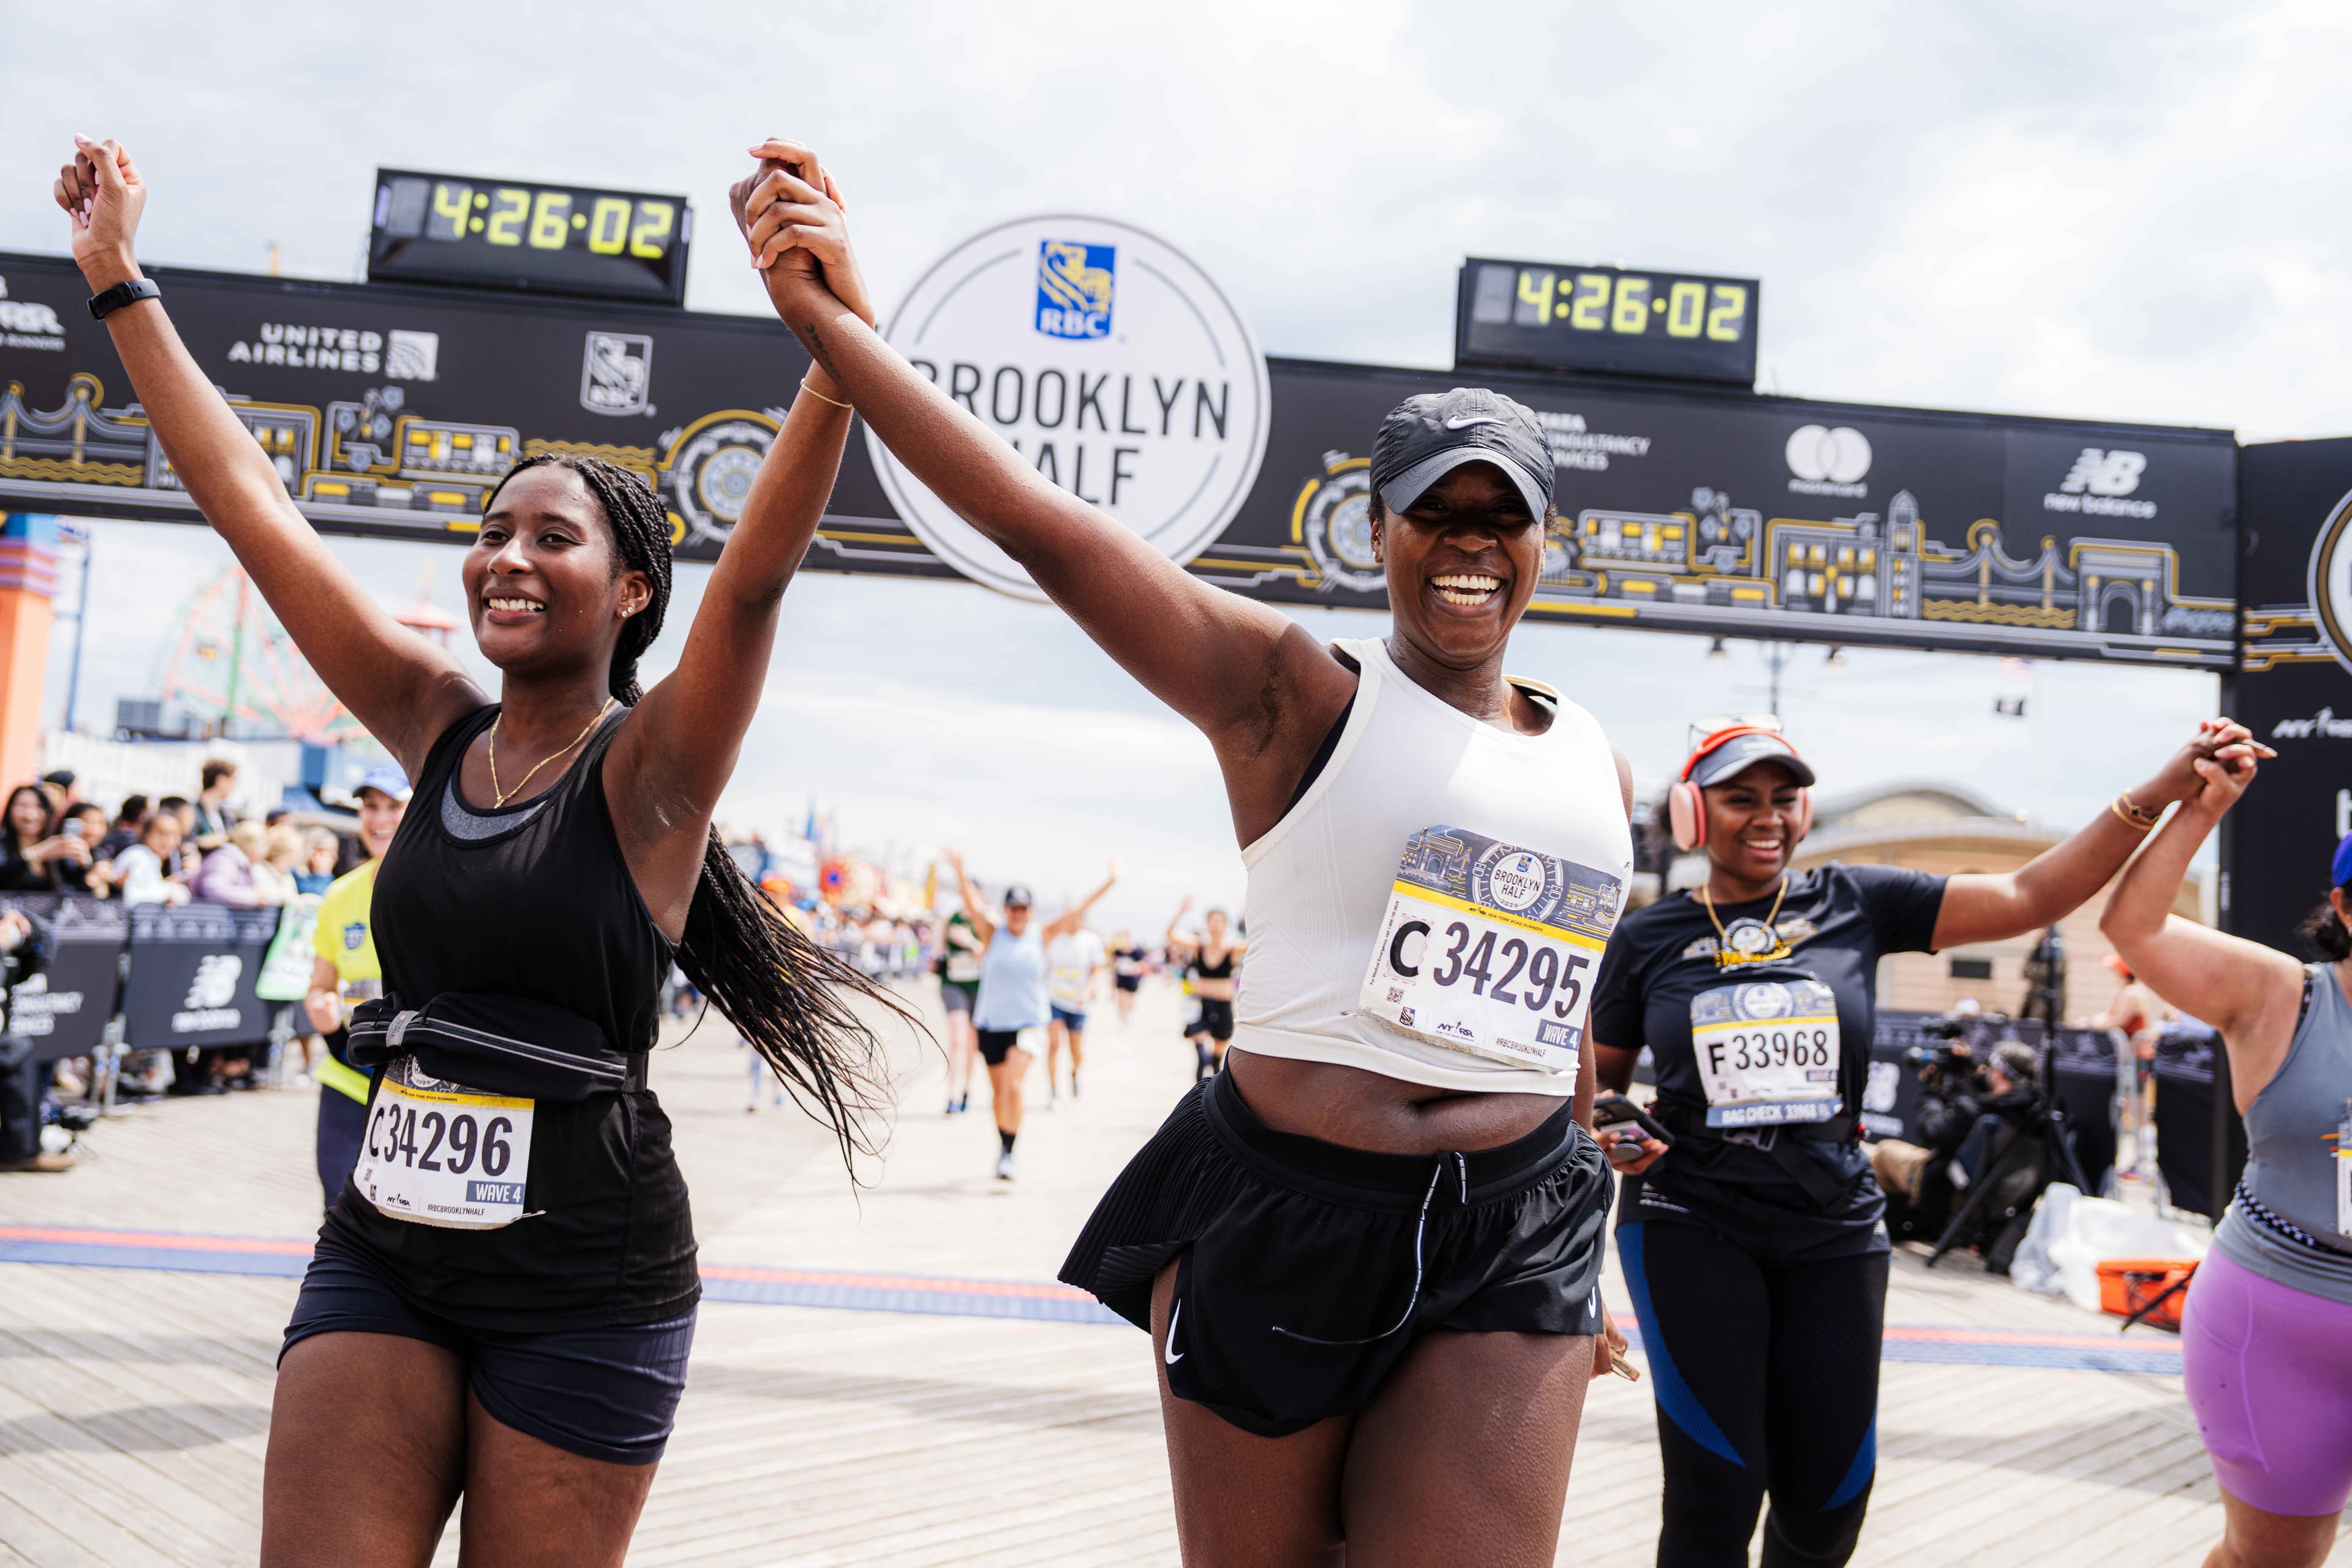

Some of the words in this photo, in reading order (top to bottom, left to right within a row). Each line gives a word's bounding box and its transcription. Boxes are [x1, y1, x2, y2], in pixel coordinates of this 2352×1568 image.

[1041, 308, 1107, 337] RBC
[260, 322, 382, 352] UNITED
[227, 341, 380, 373] AIRLINES
[1547, 431, 1651, 457] ONSULTANCY
[1014, 439, 1140, 507] ALF
[1494, 869, 1540, 892] BROOKLYN
[1501, 884, 1525, 899] HALF
[1500, 899, 1518, 908] 2025
[1523, 923, 1543, 932] RUNNERS
[1390, 921, 1431, 977] C
[1433, 921, 1590, 1019] 34295
[1542, 1023, 1569, 1046] WAVE
[1569, 1031, 1578, 1048] 4
[1709, 1042, 1725, 1074] F
[1733, 1031, 1828, 1069] 33968
[1746, 1104, 1783, 1121] CHECK
[369, 1107, 385, 1157] C
[384, 1104, 513, 1177] 34296
[475, 1183, 510, 1202] WAVE
[513, 1186, 521, 1202] 4
[428, 1204, 486, 1216] #RBCBROOKLYNHALF
